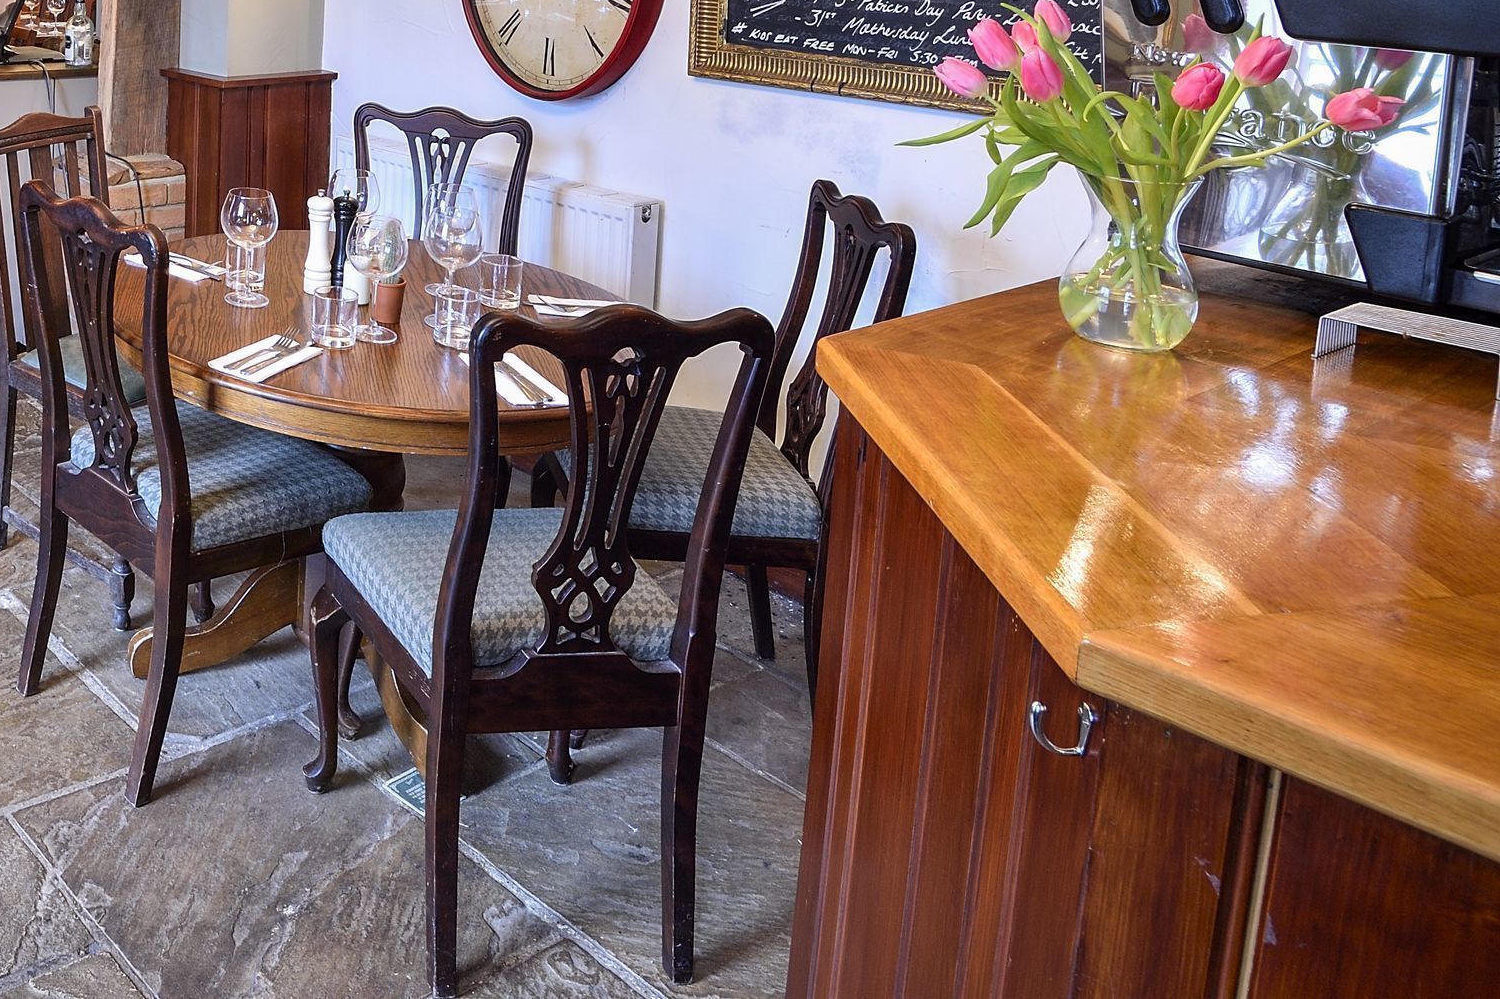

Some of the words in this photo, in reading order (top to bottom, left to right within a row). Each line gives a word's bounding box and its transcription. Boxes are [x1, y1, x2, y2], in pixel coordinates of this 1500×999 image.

[748, 28, 773, 41] KIDS
[773, 34, 799, 44] EAT
[802, 37, 835, 51] FREE
[909, 50, 939, 65] 5:30
[841, 16, 930, 52] Mothersday
